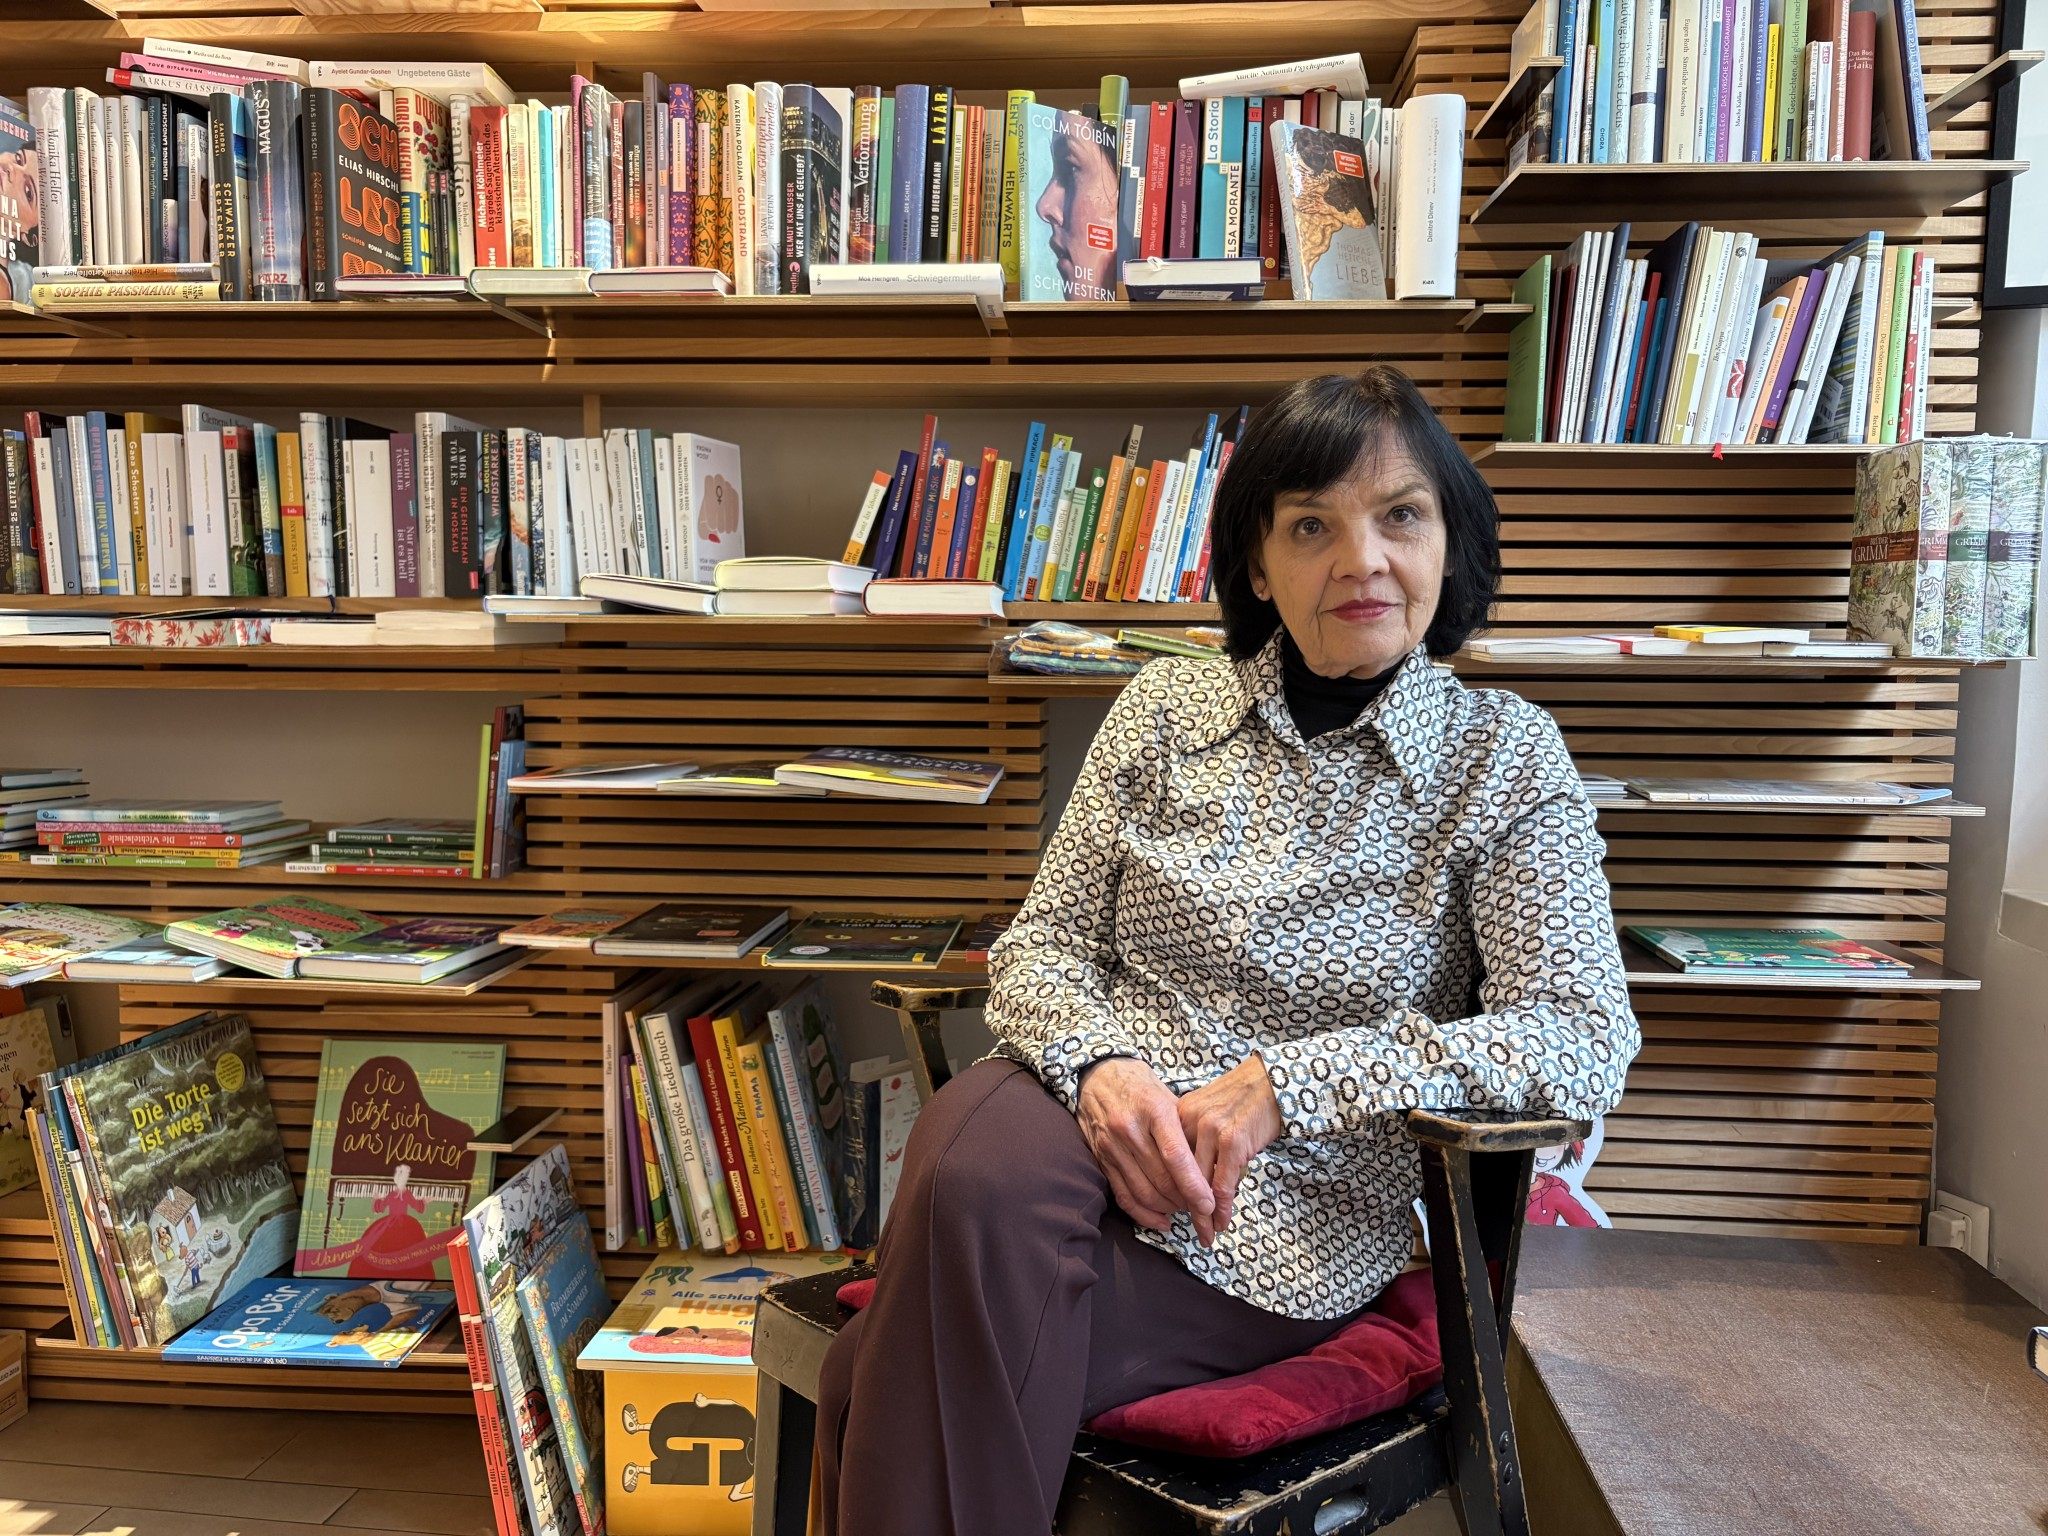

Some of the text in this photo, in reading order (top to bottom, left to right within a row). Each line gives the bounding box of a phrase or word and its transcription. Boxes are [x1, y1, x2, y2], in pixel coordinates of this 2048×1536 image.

[138, 75, 181, 89] MARKUS
[397, 69, 446, 78] Ungebetene
[447, 69, 471, 78] Gäste
[483, 123, 491, 139] des
[854, 103, 877, 190] Verformung
[1031, 114, 1117, 150] COLM TÓIBÍN
[1207, 100, 1220, 160] La Storia
[47, 127, 62, 205] Monika Helfer
[338, 155, 400, 194] ELIAS HIRSCHL
[483, 141, 493, 188] Sagenbuch
[733, 99, 741, 138] KATERINA
[737, 185, 748, 257] GOLDSTRAND
[1002, 96, 1019, 249] LENTZ HEIMWÄRTS
[475, 141, 486, 229] Michael Köhlmeier
[493, 174, 502, 224] klassischen
[796, 192, 805, 202] JE
[1229, 165, 1240, 226] MORANTE
[215, 183, 225, 257] SEPTEMBER
[223, 182, 235, 257] SCHWARZER
[486, 216, 494, 233] Das
[796, 204, 805, 220] UNS
[862, 193, 870, 224] Kresser
[787, 226, 795, 258] HELMUT
[796, 221, 805, 238] HAT
[796, 239, 805, 258] WER
[107, 285, 178, 297] PASSMANN
[1033, 274, 1116, 303] SCHWESTERN
[1074, 266, 1094, 282] DIE
[449, 440, 458, 486] TOWLES
[459, 447, 467, 479] AMOR
[1127, 439, 1138, 461] BERG
[5, 445, 18, 522] 25 LETZTE SOMMER
[515, 438, 525, 502] 22 BAHNEN
[259, 471, 274, 555] SALZWASSER
[451, 498, 459, 553] IN MOSKAU
[461, 505, 469, 564] GENTLEMAN
[1854, 545, 1888, 562] GRIMM
[406, 526, 415, 584] Nur nachts
[364, 1067, 405, 1095] Sie
[654, 1030, 696, 1163] Das große Liederbuch
[131, 1083, 211, 1130] Die Torte
[346, 1098, 436, 1140] setzt sich
[137, 1126, 165, 1154] ist
[342, 1132, 467, 1170] ans Klavier
[672, 1290, 705, 1299] Alle
[678, 1300, 755, 1317] Hug
[211, 1284, 303, 1348] Opa Bär
